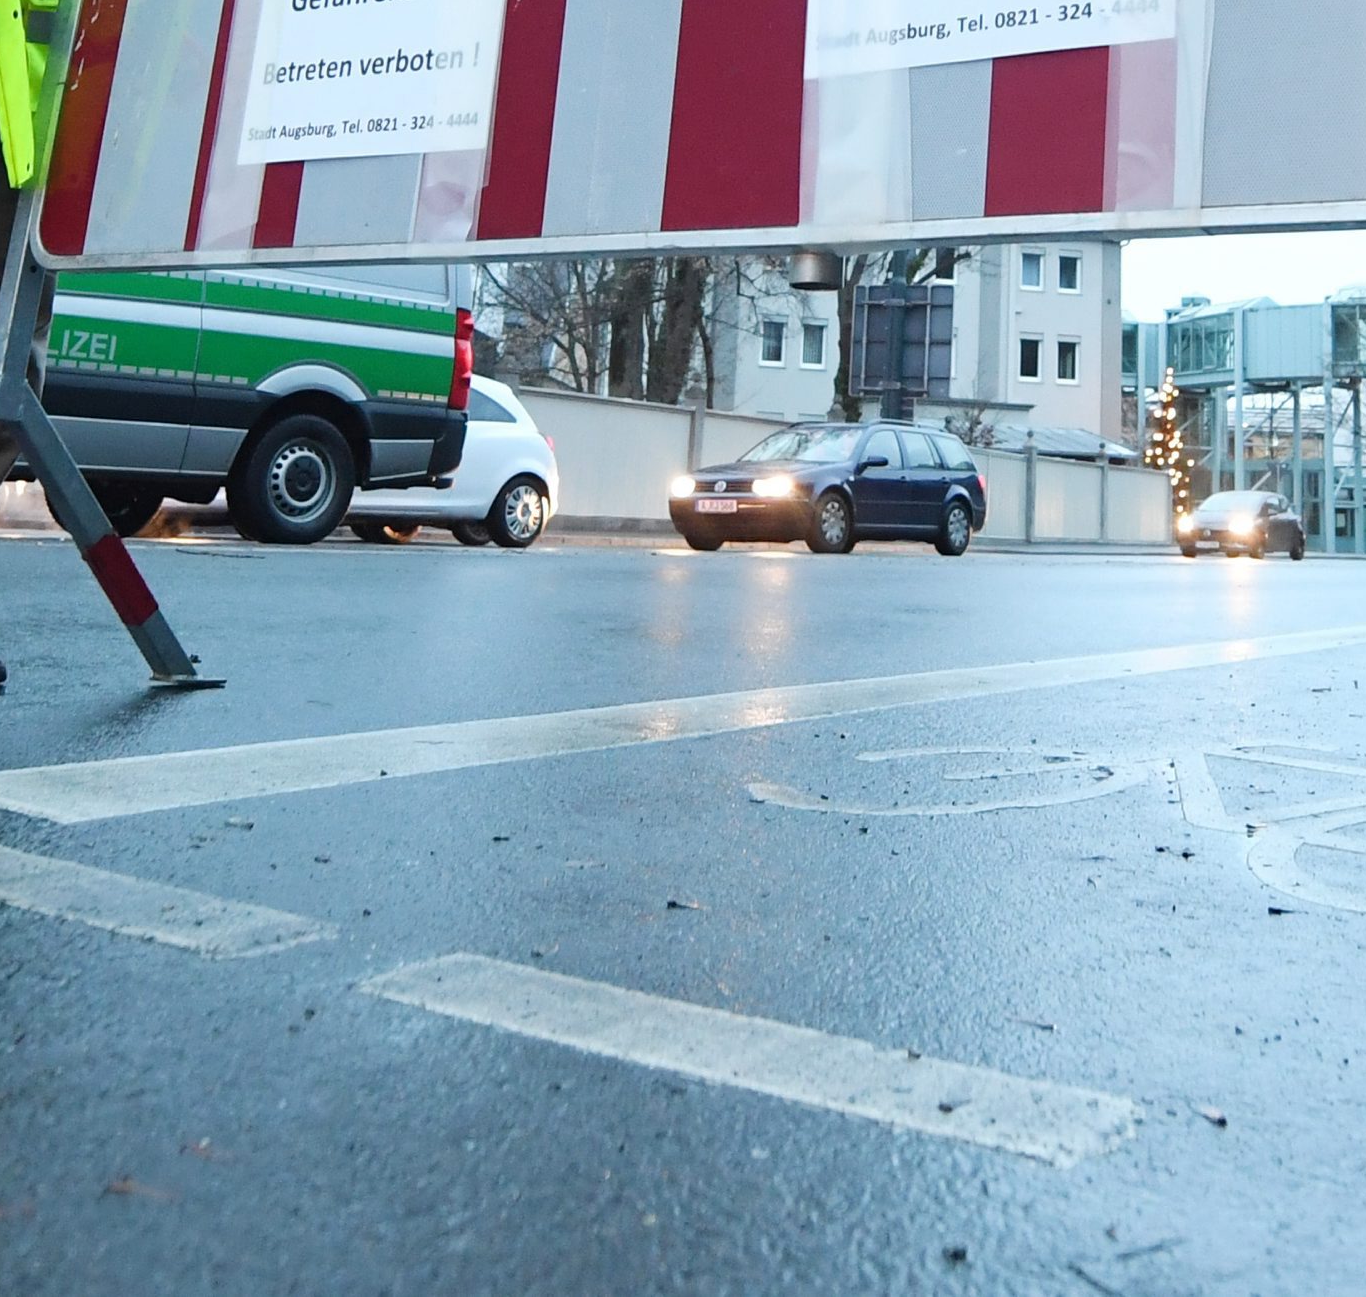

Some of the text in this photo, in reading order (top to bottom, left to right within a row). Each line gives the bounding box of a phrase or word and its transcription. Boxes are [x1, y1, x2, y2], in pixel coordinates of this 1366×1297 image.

[865, 23, 951, 45] Augsburg,
[957, 14, 988, 33] Tel.
[995, 8, 1039, 29] 0821
[1058, 2, 1092, 21] 324
[263, 42, 480, 85] Betreten verboten !
[247, 126, 277, 141] Stadt
[278, 122, 337, 140] Augsburg,
[342, 119, 364, 134] Tel.
[367, 117, 397, 132] 0821
[410, 115, 434, 130] 324
